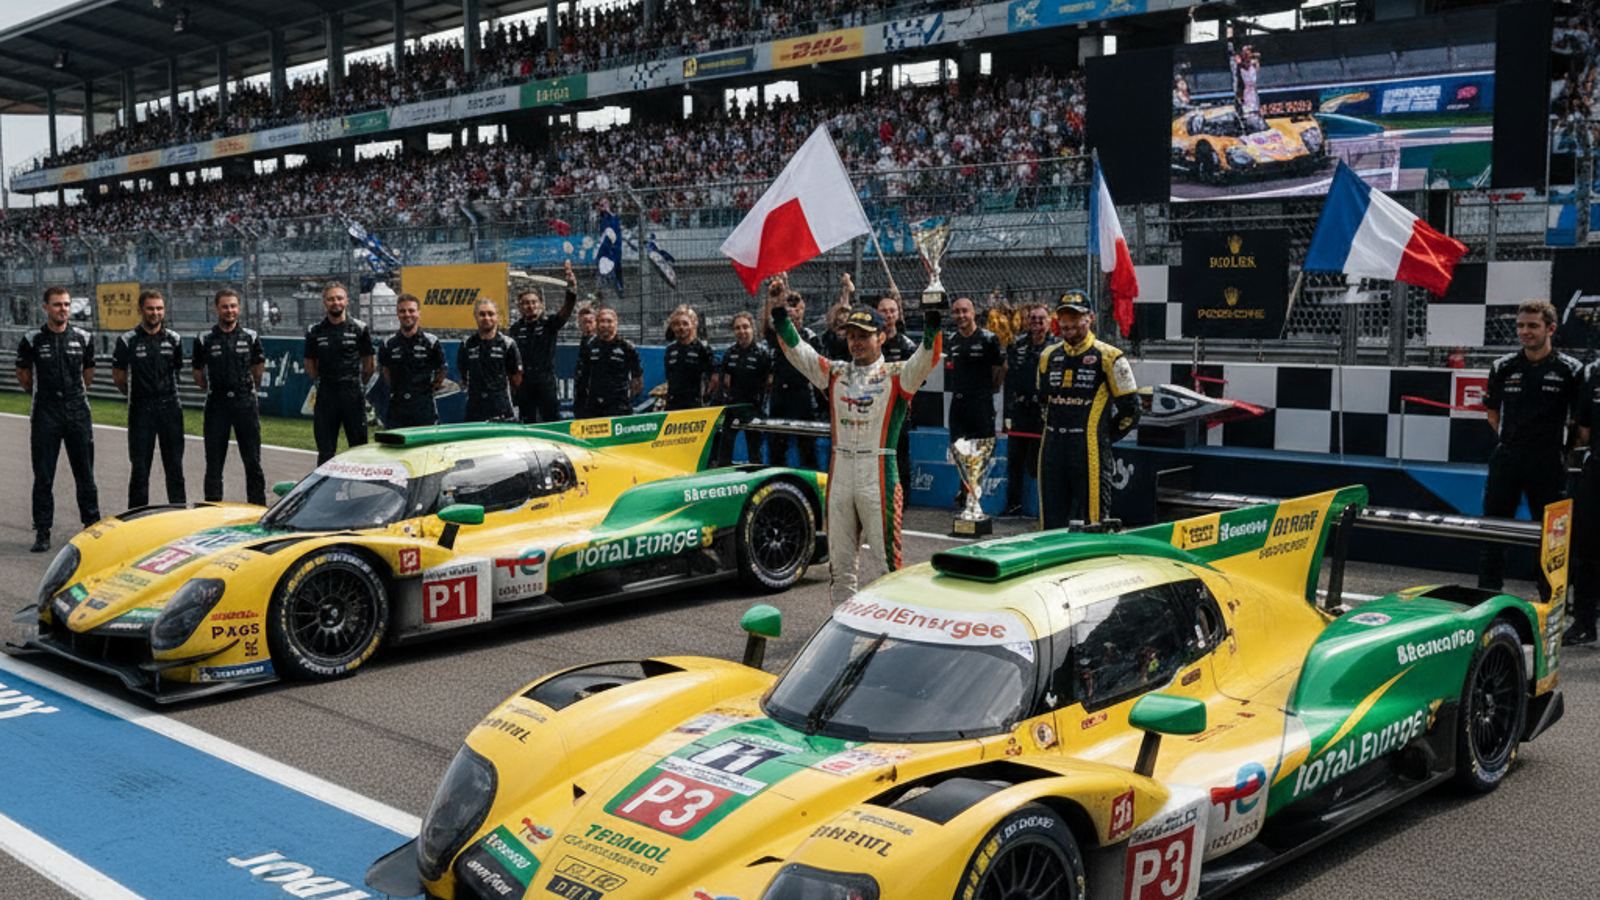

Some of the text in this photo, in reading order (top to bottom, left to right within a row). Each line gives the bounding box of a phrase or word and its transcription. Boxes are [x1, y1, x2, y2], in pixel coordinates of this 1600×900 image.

[429, 581, 467, 619] P1
[211, 623, 260, 639] PAGS
[622, 777, 715, 827] P3
[1130, 839, 1186, 900] P3
